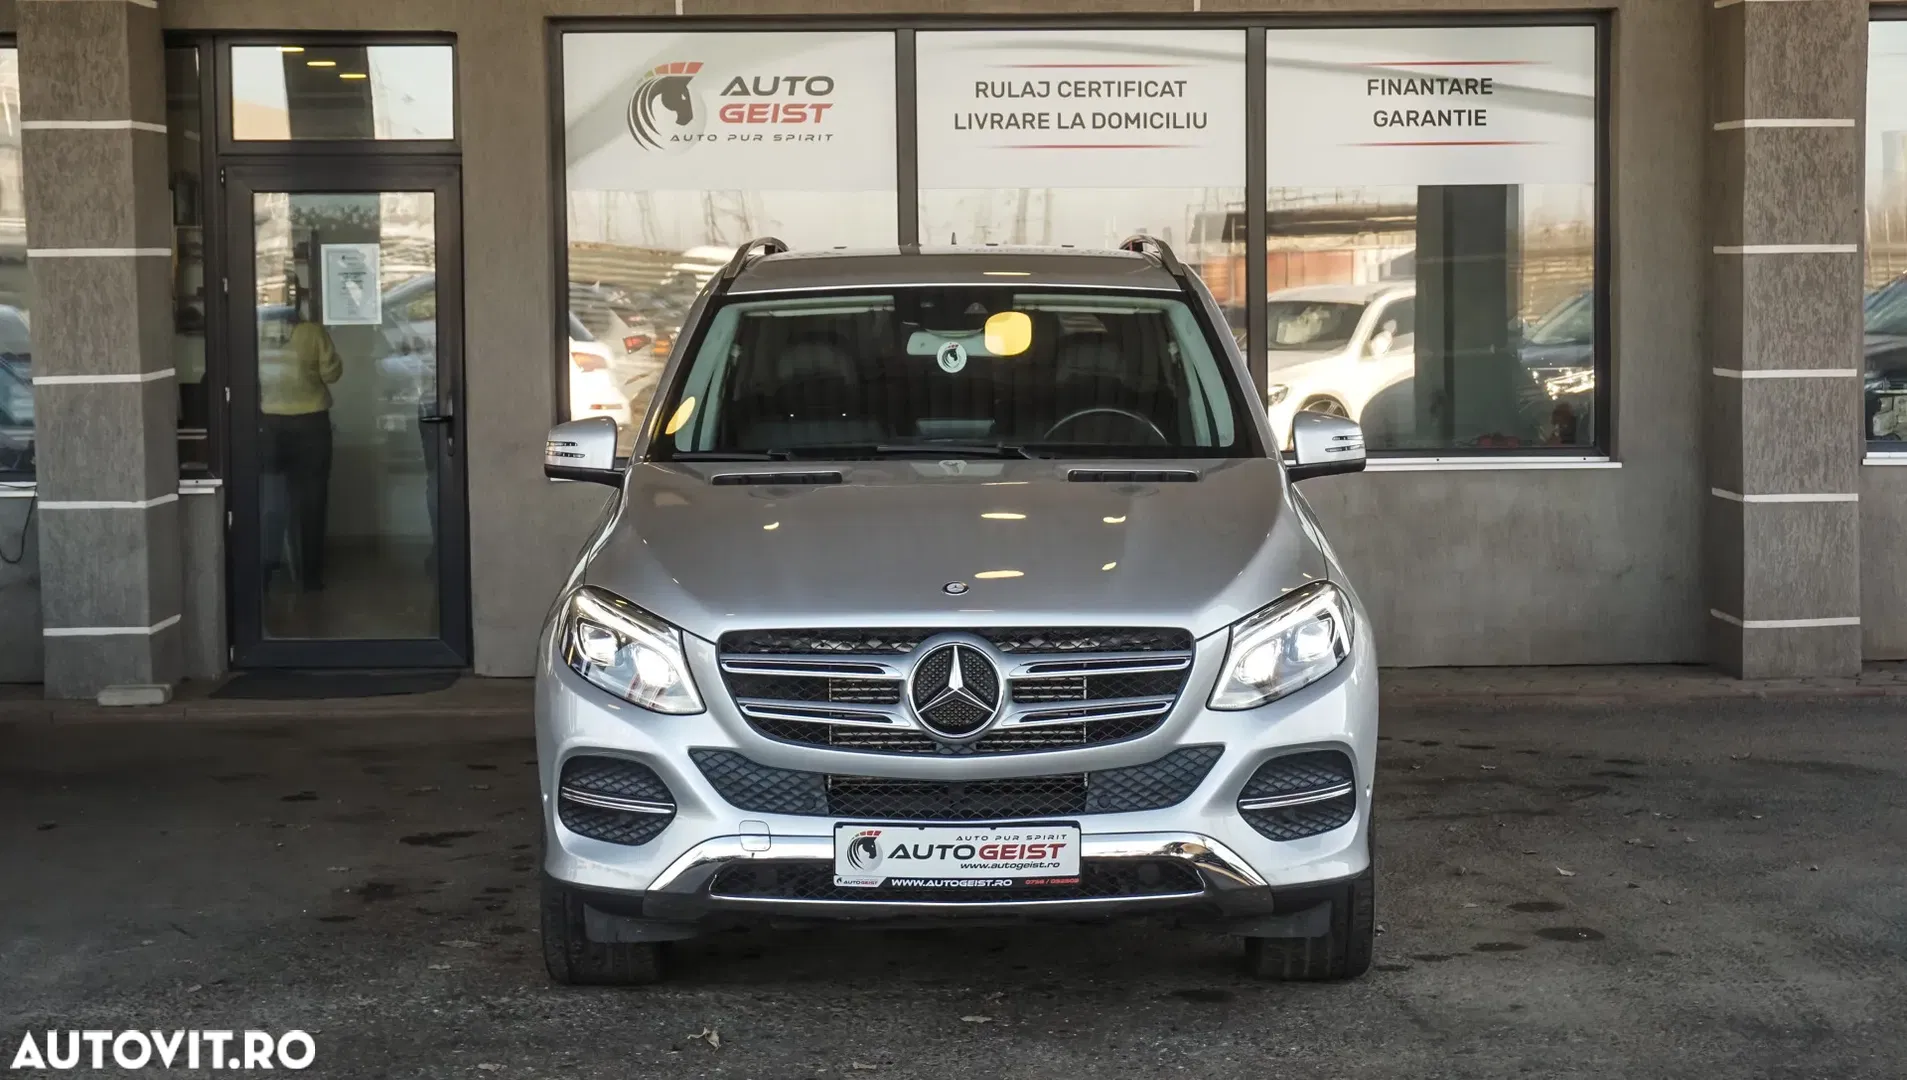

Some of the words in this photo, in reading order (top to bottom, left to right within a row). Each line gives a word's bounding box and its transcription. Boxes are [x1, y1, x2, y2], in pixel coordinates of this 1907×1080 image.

[719, 76, 835, 96] AUTO
[974, 81, 1051, 98] RULAJ
[1057, 80, 1188, 98] CERTIFICAT
[1366, 77, 1494, 96] FINANTARE
[719, 103, 834, 124] GEIST
[954, 112, 1050, 130] LIVRARE
[1057, 112, 1086, 130] LA
[1091, 111, 1208, 130] DOMICILIU
[1372, 109, 1487, 127] GARANTIE
[670, 134, 718, 142] AUTO
[727, 134, 764, 142] PUR
[773, 134, 834, 142] SPIRIT
[887, 843, 1067, 861] AUTOGEIST
[960, 861, 1060, 870] www.autogeist.ro
[891, 878, 1013, 887] WWW.AUTOGEIST.RO
